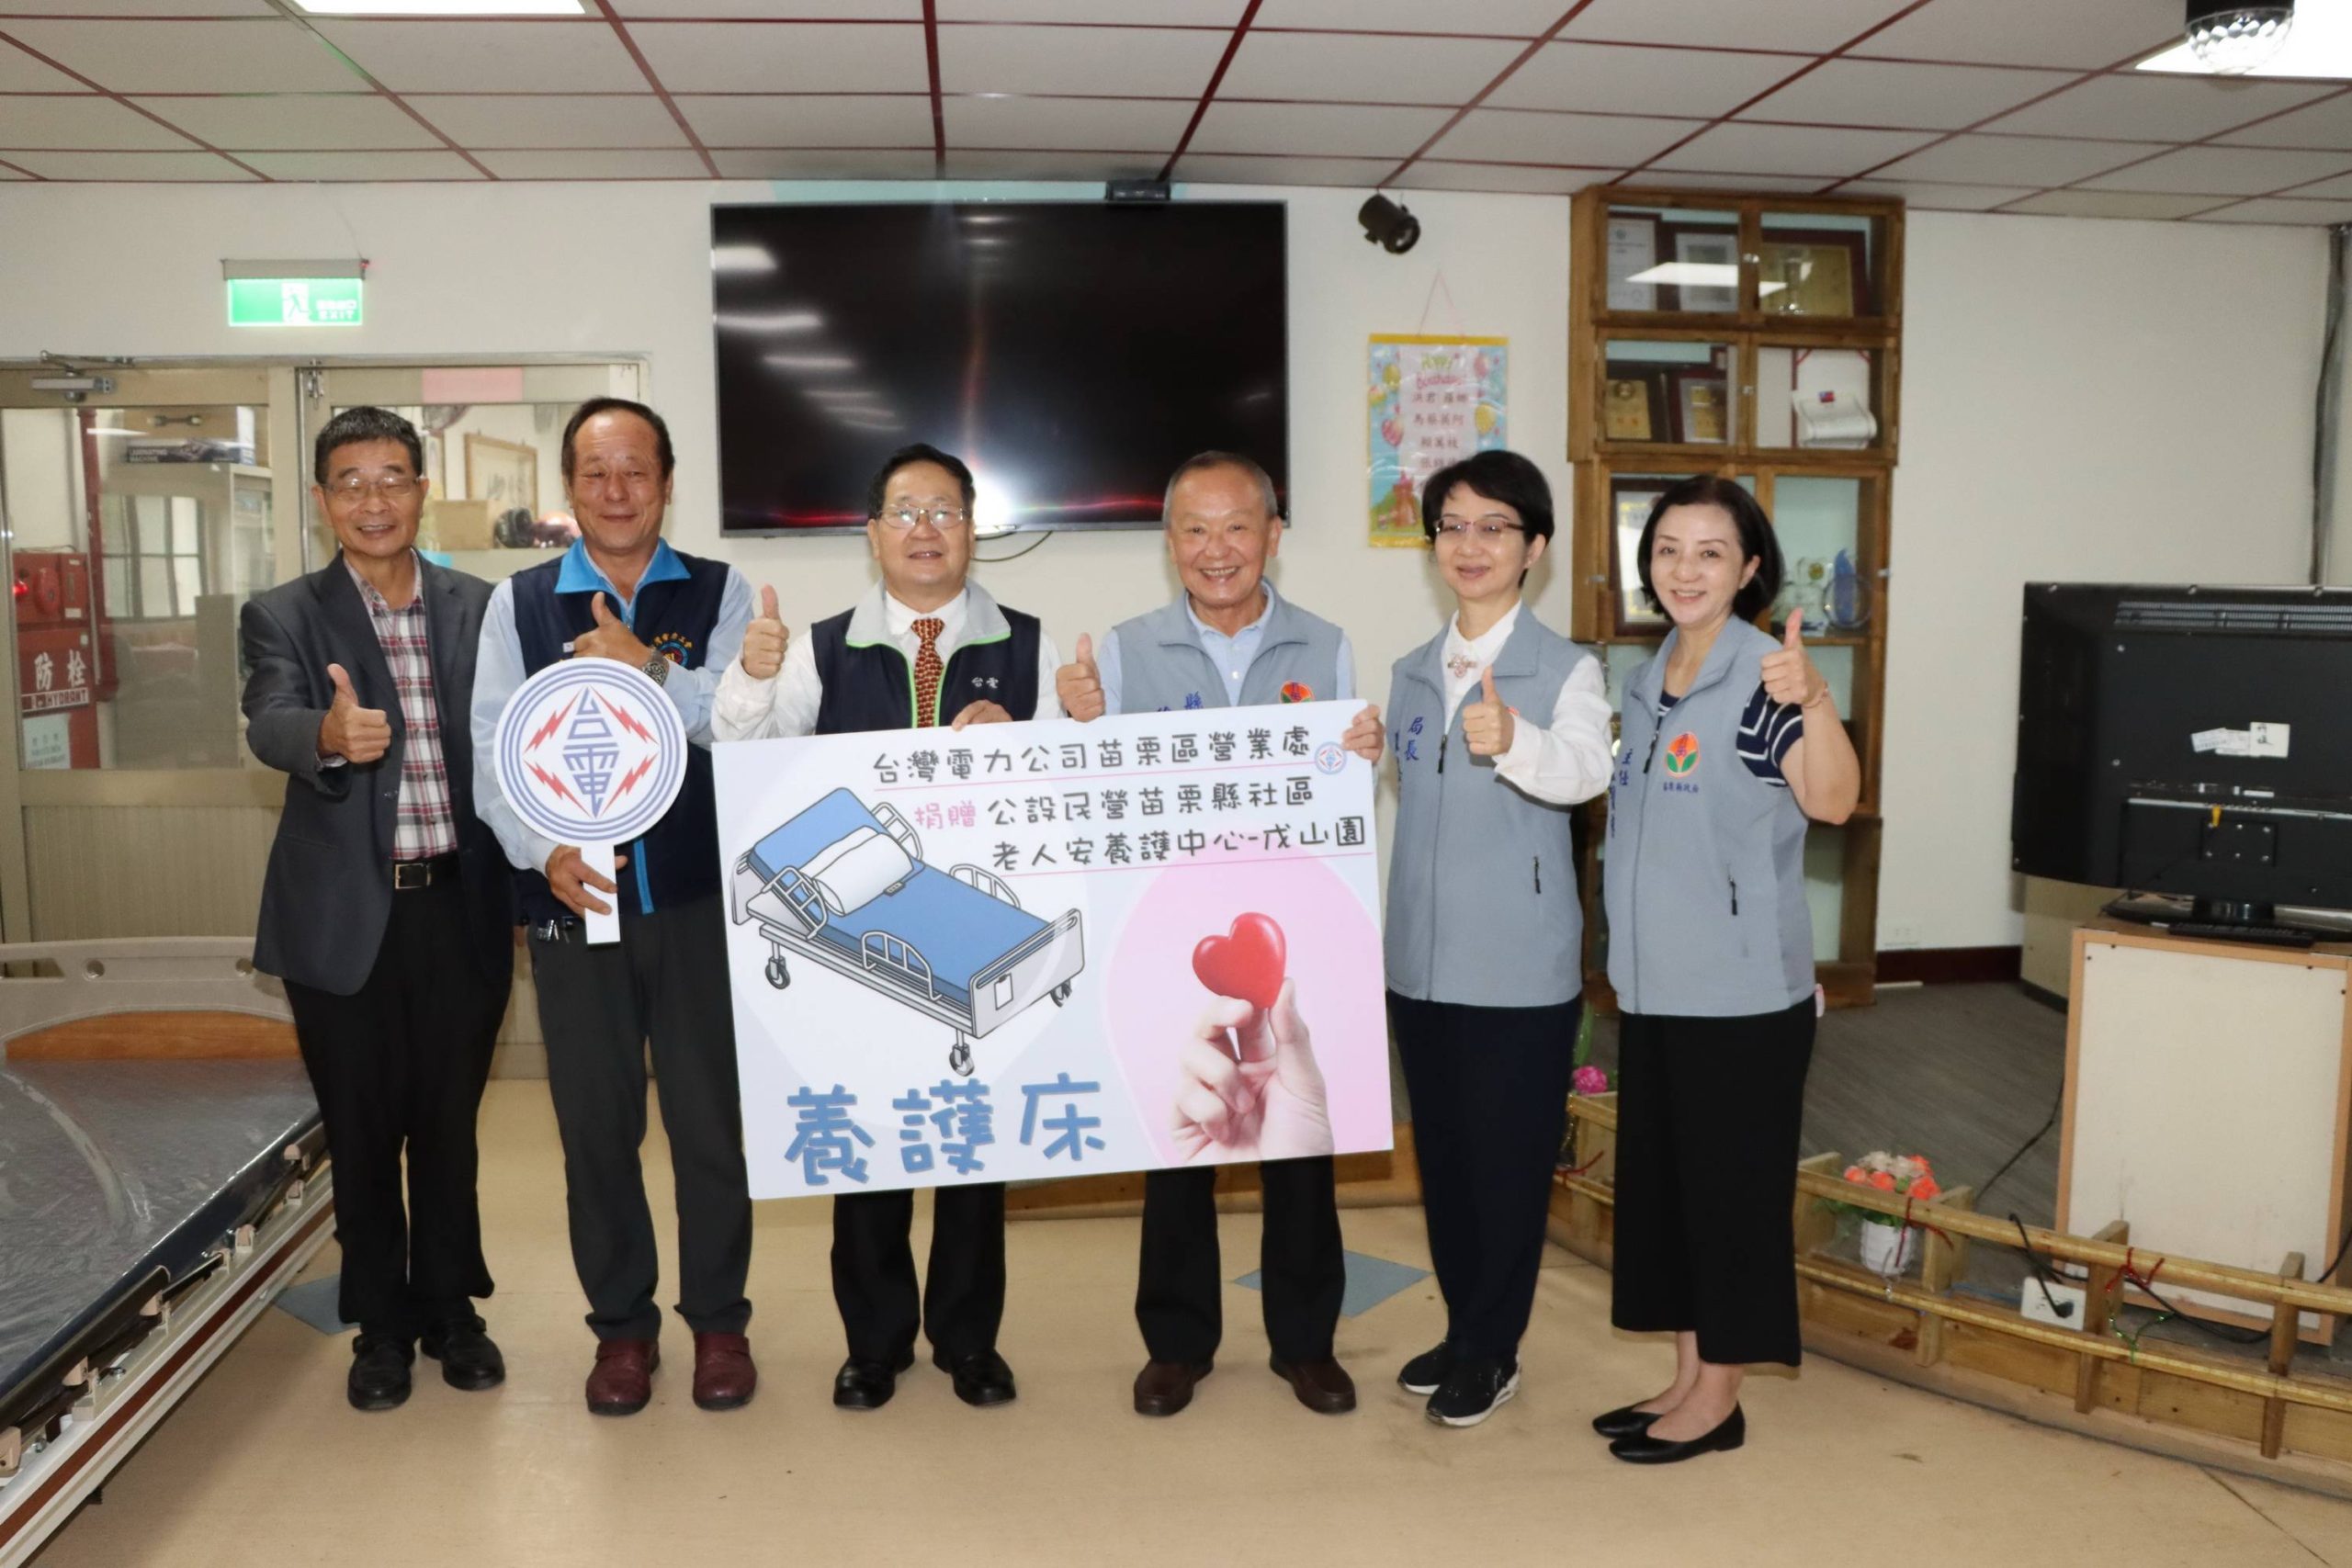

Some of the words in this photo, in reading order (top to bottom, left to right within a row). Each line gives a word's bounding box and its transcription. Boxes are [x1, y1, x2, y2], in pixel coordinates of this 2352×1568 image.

[319, 310, 354, 320] EXIT
[872, 726, 1310, 784] 台灣電力公司苗栗區營業處
[1405, 716, 1424, 761] 局長
[914, 800, 977, 829] 捐贈
[988, 776, 1313, 826] 公設民營苗栗縣社區
[785, 1073, 1106, 1187] 養護床
